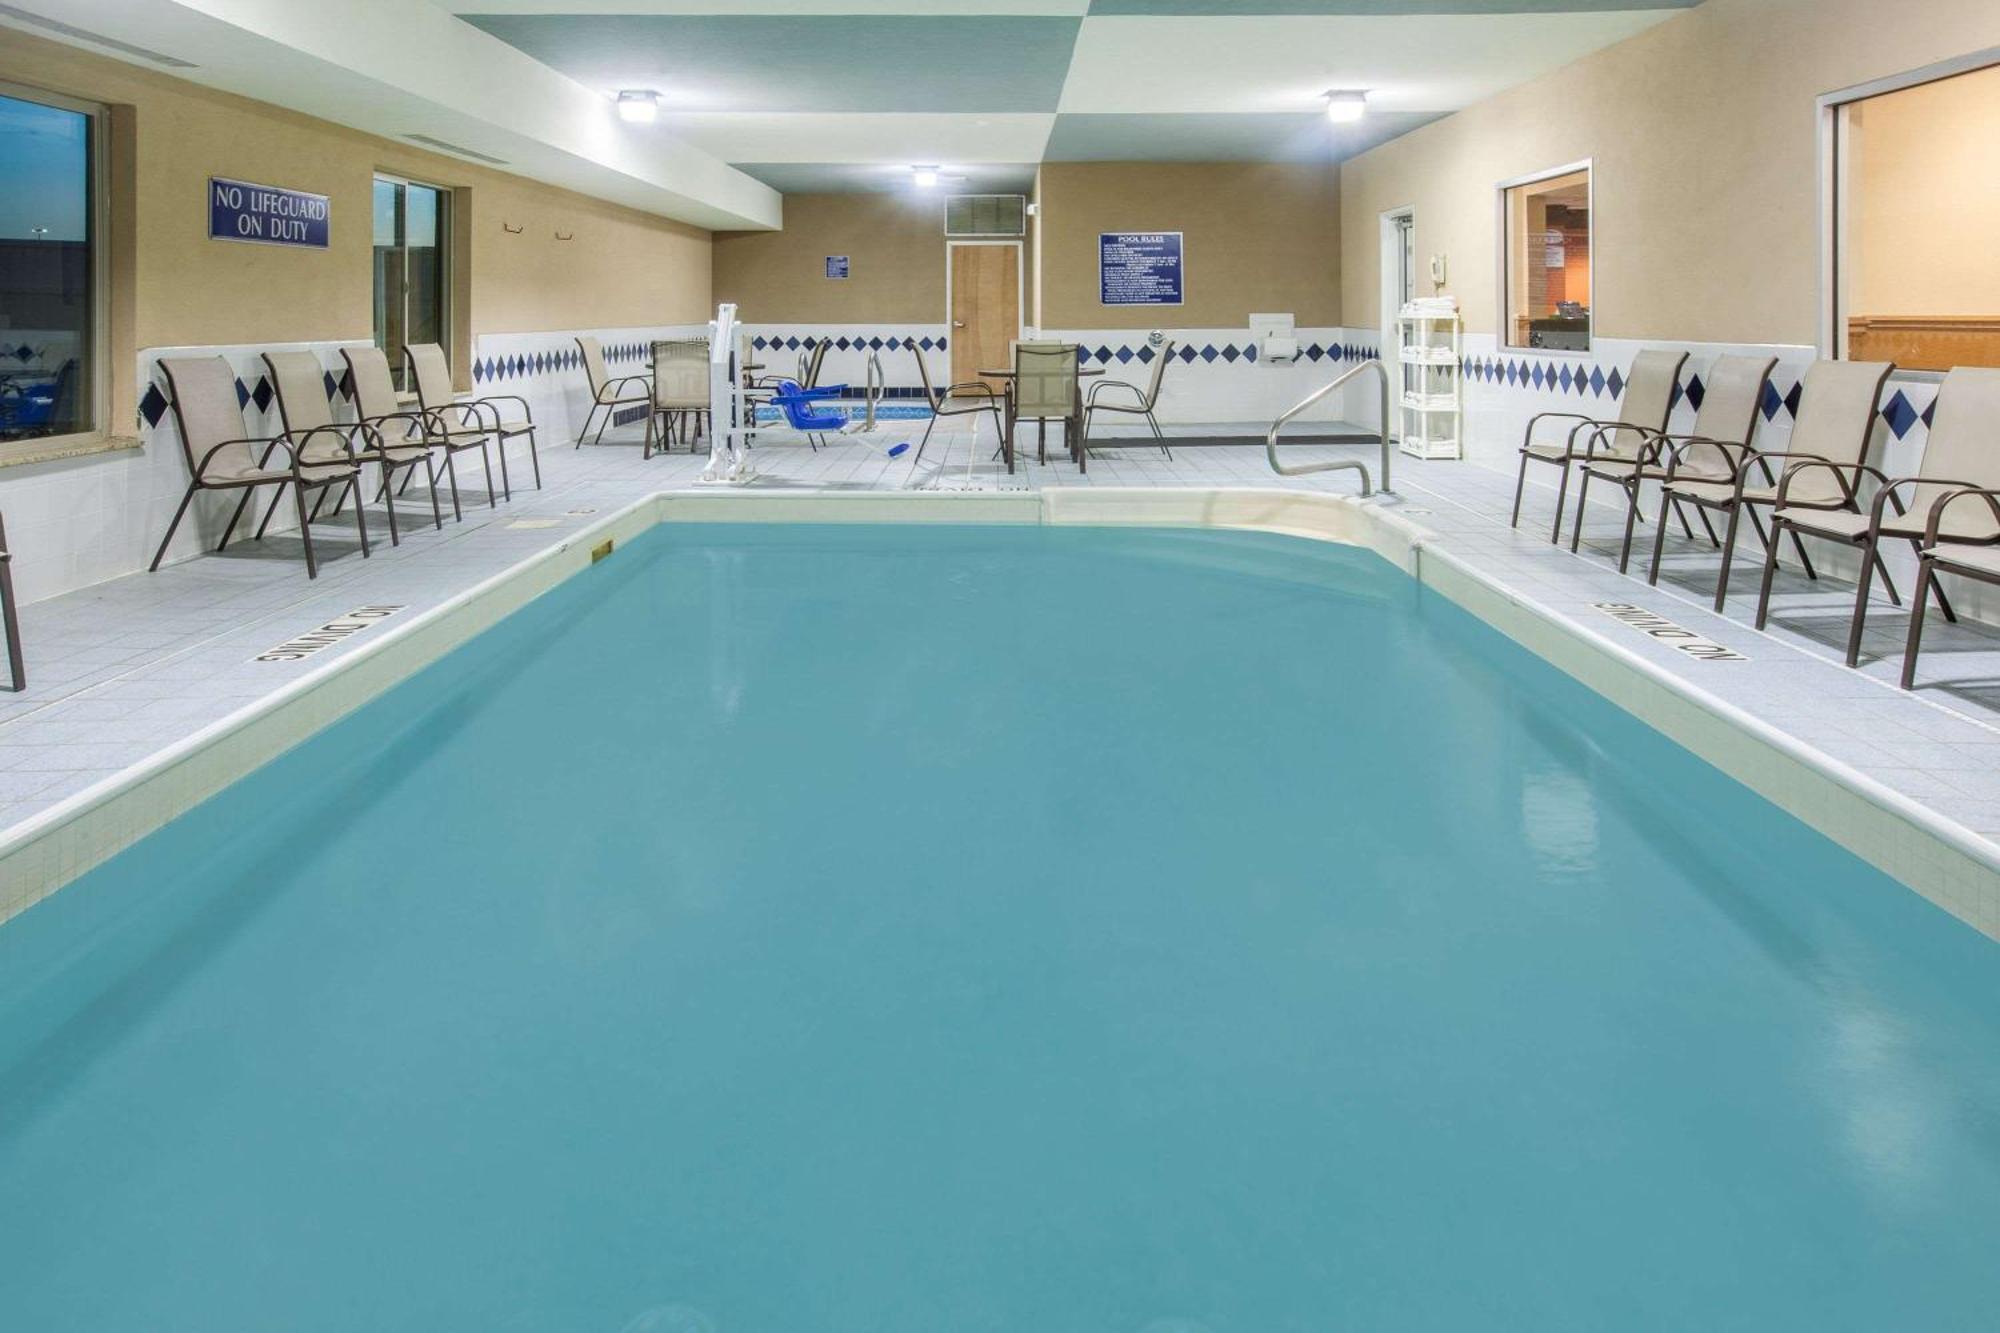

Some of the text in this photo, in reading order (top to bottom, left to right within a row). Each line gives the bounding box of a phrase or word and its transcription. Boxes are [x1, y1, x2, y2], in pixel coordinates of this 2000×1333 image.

[216, 186, 325, 221] NO LIFEGUARD
[238, 214, 309, 241] ON DUTY
[1118, 235, 1164, 243] POOL RULES
[256, 604, 405, 661] NO DIVING
[1593, 603, 1748, 660] NO DIVING
